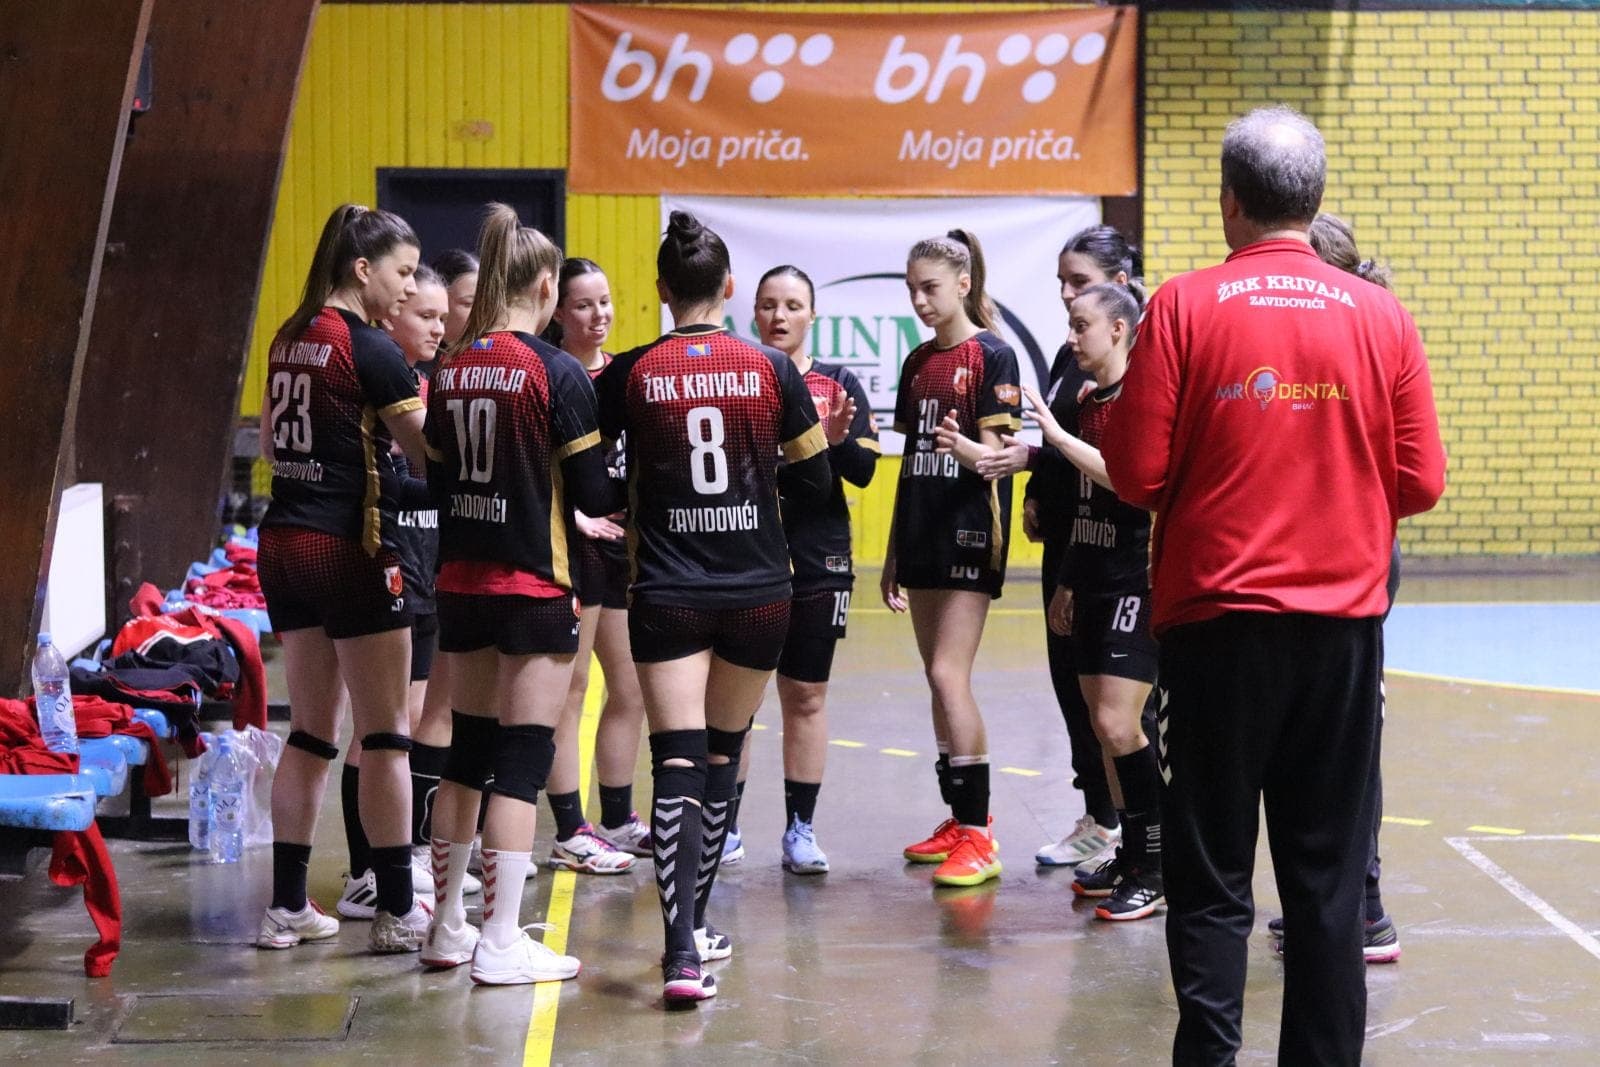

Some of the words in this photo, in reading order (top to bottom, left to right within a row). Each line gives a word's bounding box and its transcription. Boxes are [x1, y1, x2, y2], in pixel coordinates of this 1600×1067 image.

[602, 32, 713, 102] bh
[874, 34, 986, 103] bh
[626, 128, 711, 167] Moja
[717, 128, 809, 167] priča.
[899, 130, 984, 169] Moja
[990, 130, 1081, 168] priča.
[1217, 276, 1262, 303] ŽRK
[1265, 275, 1356, 308] KRIVAJA
[1249, 295, 1326, 309] ZAVIDOVIĆI
[460, 366, 526, 394] KRIVAJA
[643, 371, 678, 403] ŽRK
[683, 372, 761, 399] KRIVAJA
[1215, 383, 1244, 400] MR
[1279, 383, 1350, 400] DENTAL
[272, 371, 313, 453] 23
[447, 398, 497, 483] 10
[687, 406, 729, 495] 8
[668, 499, 758, 533] ZAVIDOVIĆI
[832, 591, 850, 625] 19
[1111, 596, 1141, 632] 13
